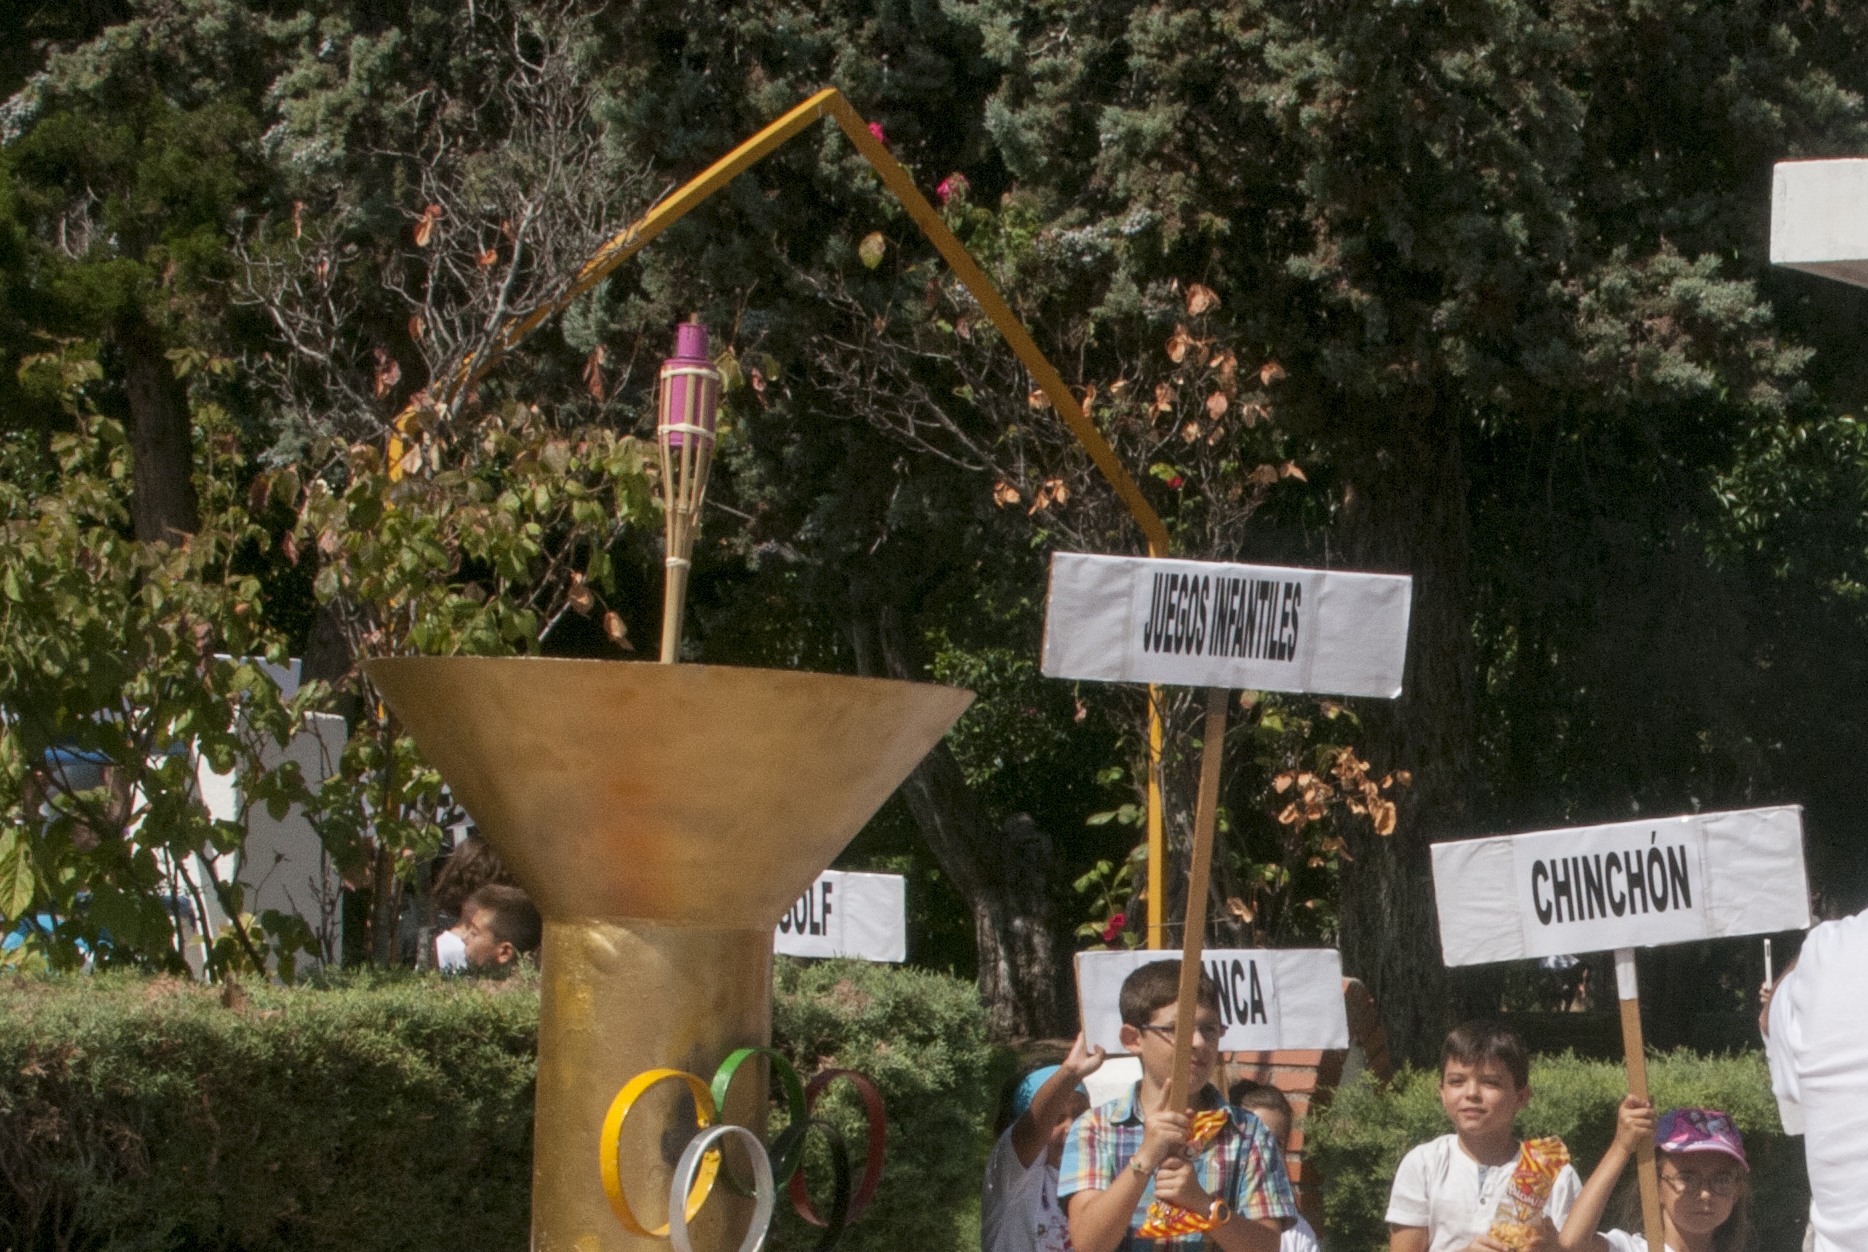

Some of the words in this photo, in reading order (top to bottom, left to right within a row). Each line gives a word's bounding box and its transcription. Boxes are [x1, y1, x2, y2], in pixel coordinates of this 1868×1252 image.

[1144, 572, 1210, 656] JUEGOS
[1208, 577, 1302, 662] INFANTILES
[1531, 830, 1692, 926] CHINCHÓN
[1203, 959, 1268, 1025] NCA
